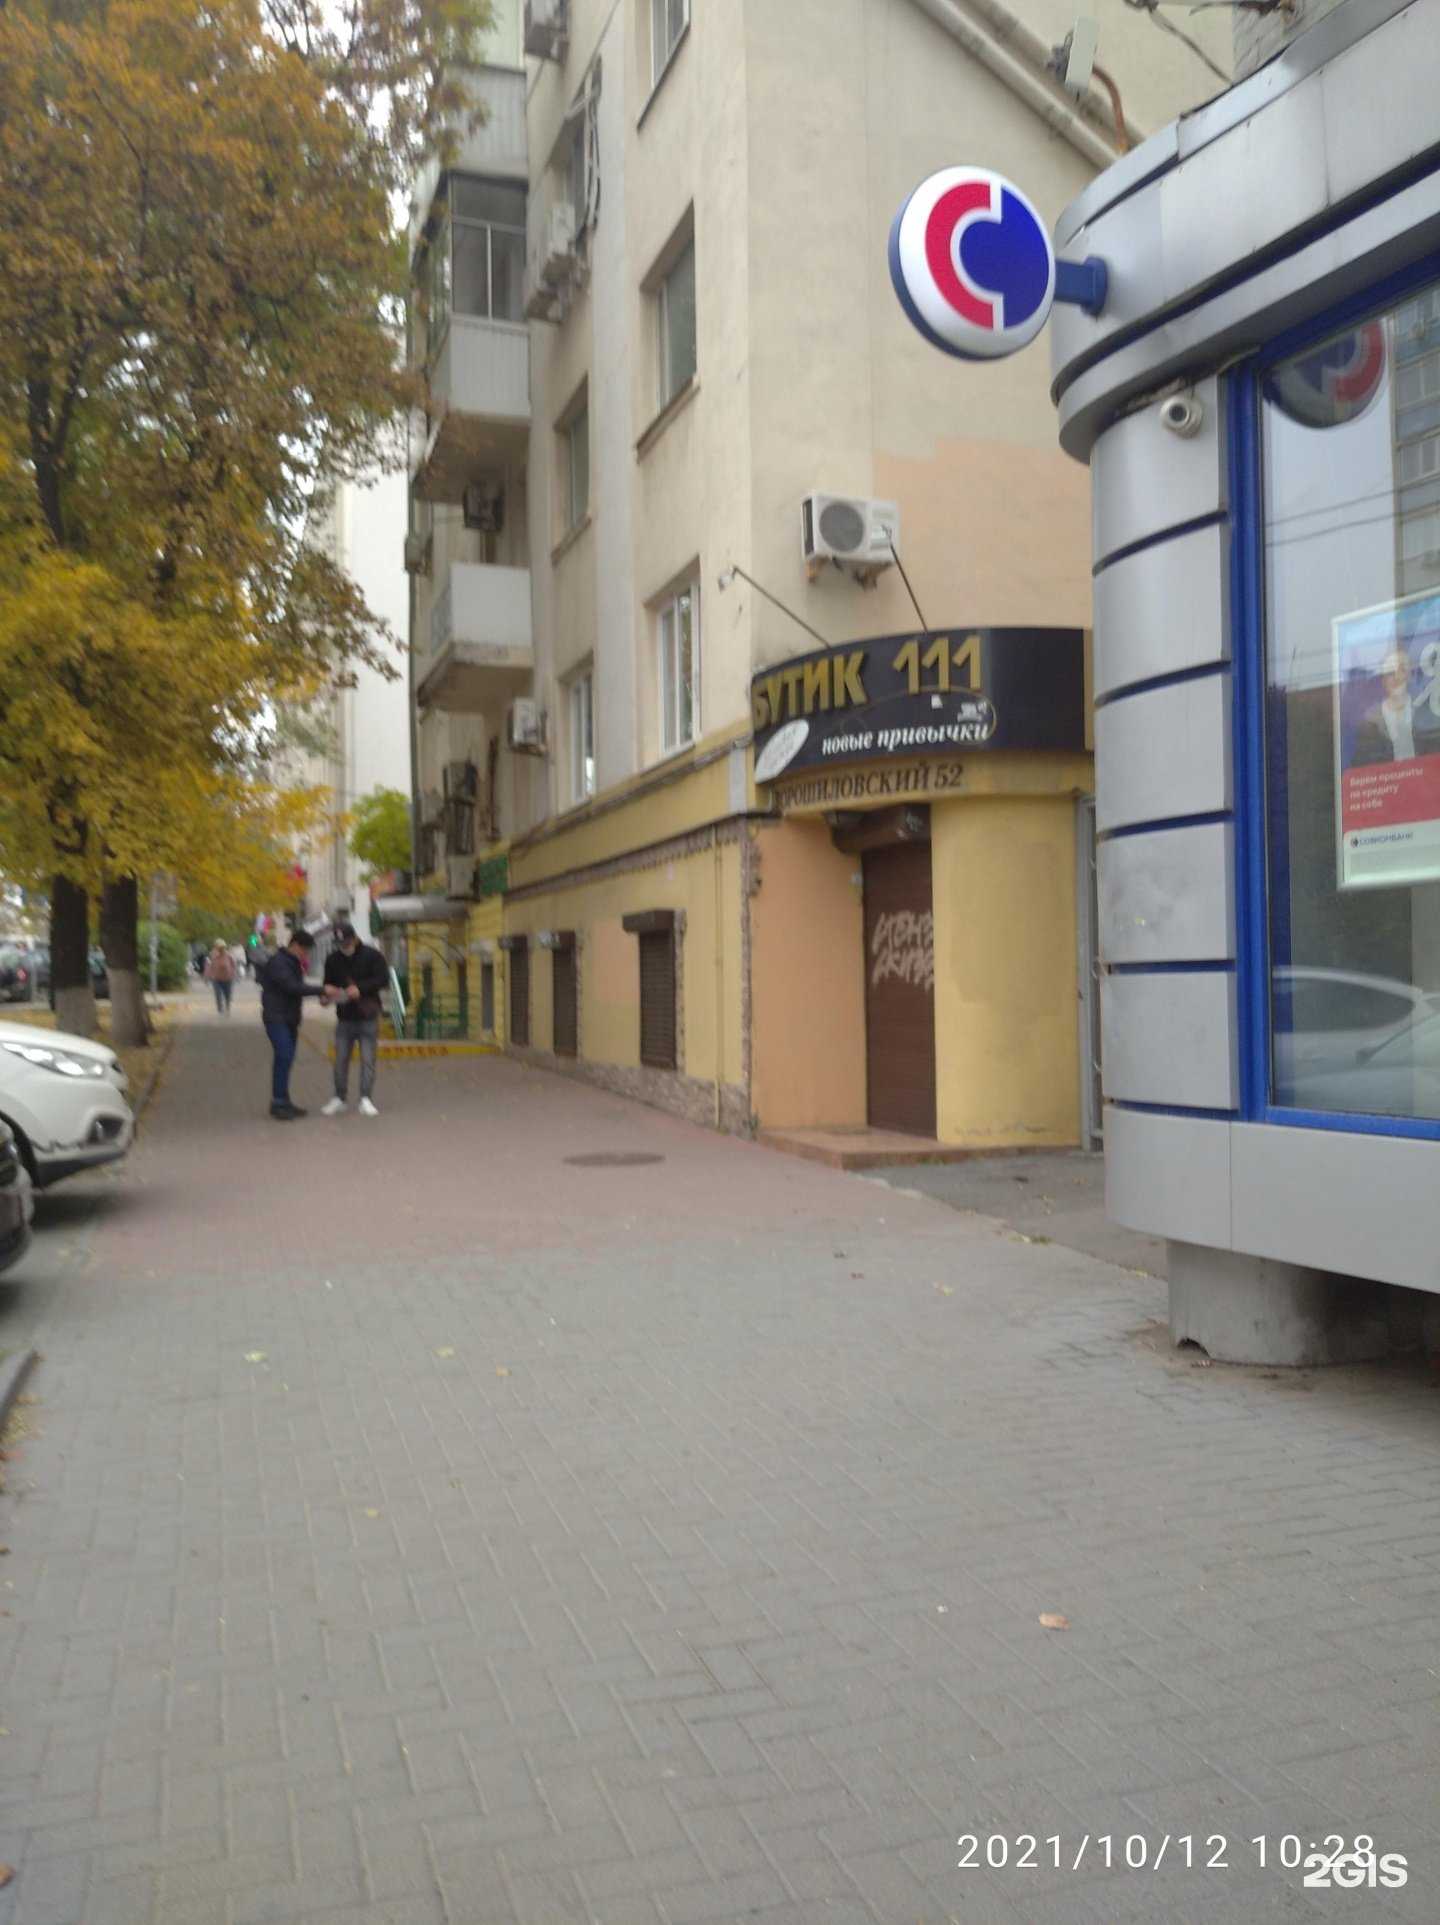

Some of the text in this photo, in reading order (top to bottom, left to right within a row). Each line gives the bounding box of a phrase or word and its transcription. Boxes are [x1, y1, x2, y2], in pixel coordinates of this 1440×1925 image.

[751, 635, 982, 732] БУТИК 111
[822, 732, 873, 756] новые
[877, 723, 989, 751] привычки
[934, 763, 964, 788] 52
